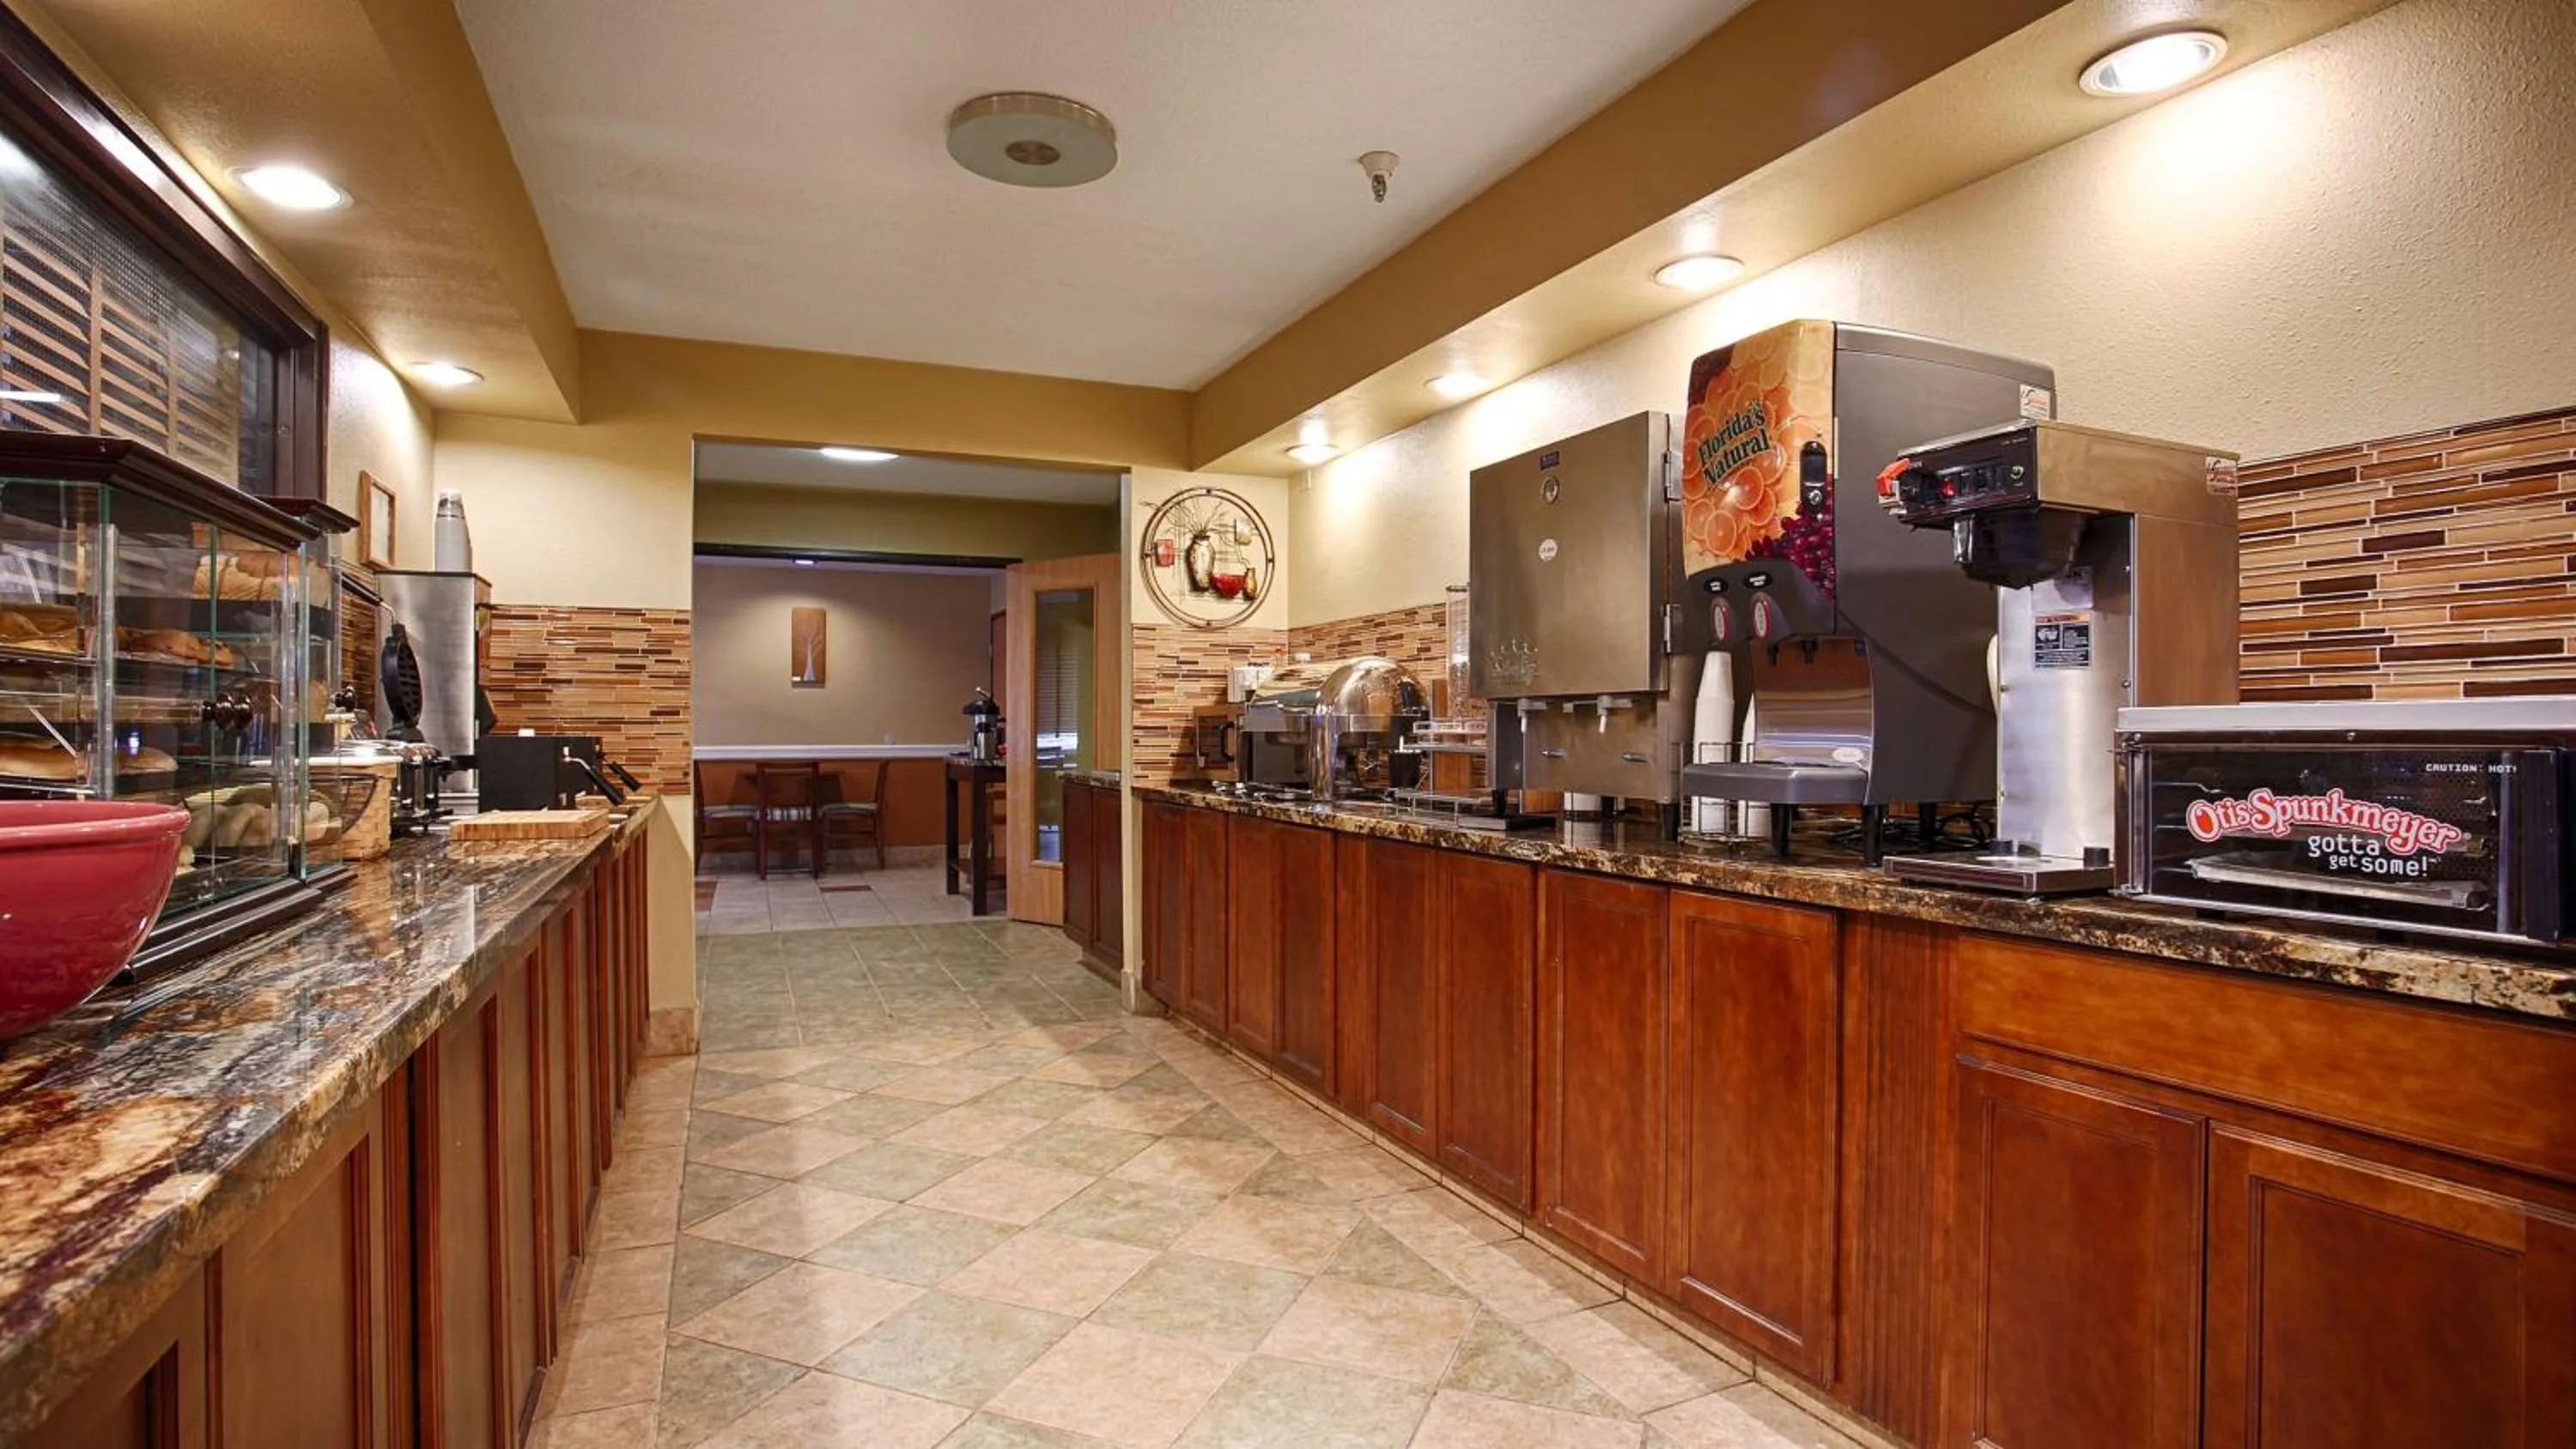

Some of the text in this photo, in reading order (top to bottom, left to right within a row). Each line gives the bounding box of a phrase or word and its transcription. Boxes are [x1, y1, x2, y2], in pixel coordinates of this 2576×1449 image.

[1698, 399, 1765, 466] Florida's
[1703, 428, 1770, 484] Natural
[2248, 787, 2462, 855] Spunkmeyer
[2307, 835, 2379, 858] gotta
[2329, 855, 2427, 876] get some!
